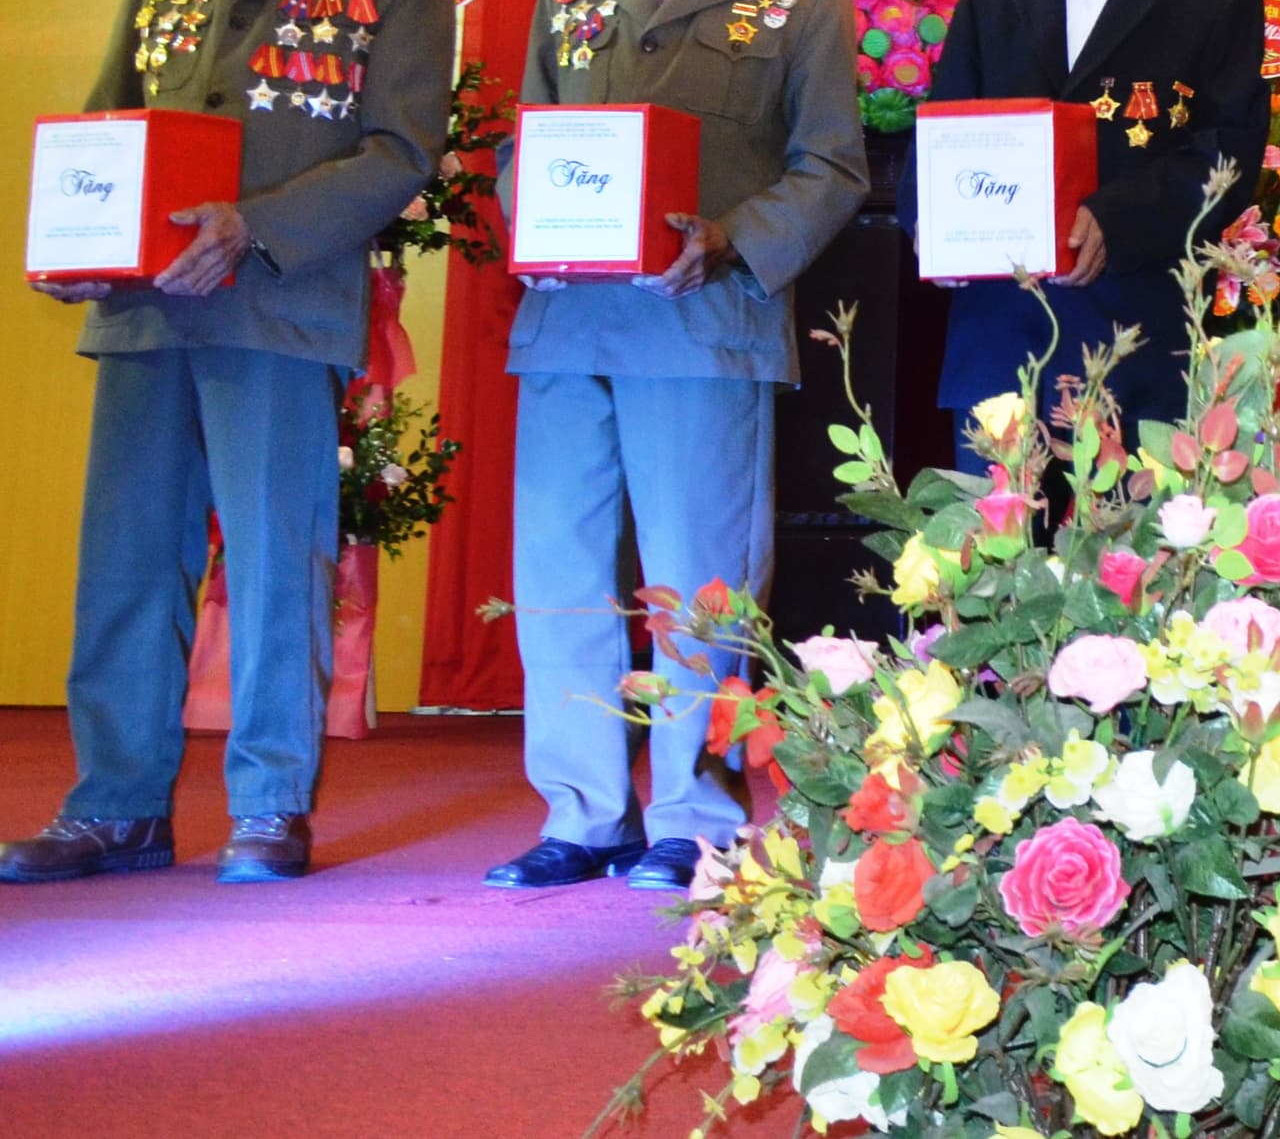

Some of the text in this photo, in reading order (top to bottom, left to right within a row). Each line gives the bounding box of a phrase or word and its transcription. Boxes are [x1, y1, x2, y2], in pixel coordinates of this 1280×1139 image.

[60, 168, 114, 202] Tặng
[548, 158, 612, 194] Tặng
[955, 169, 1021, 205] Tặng
